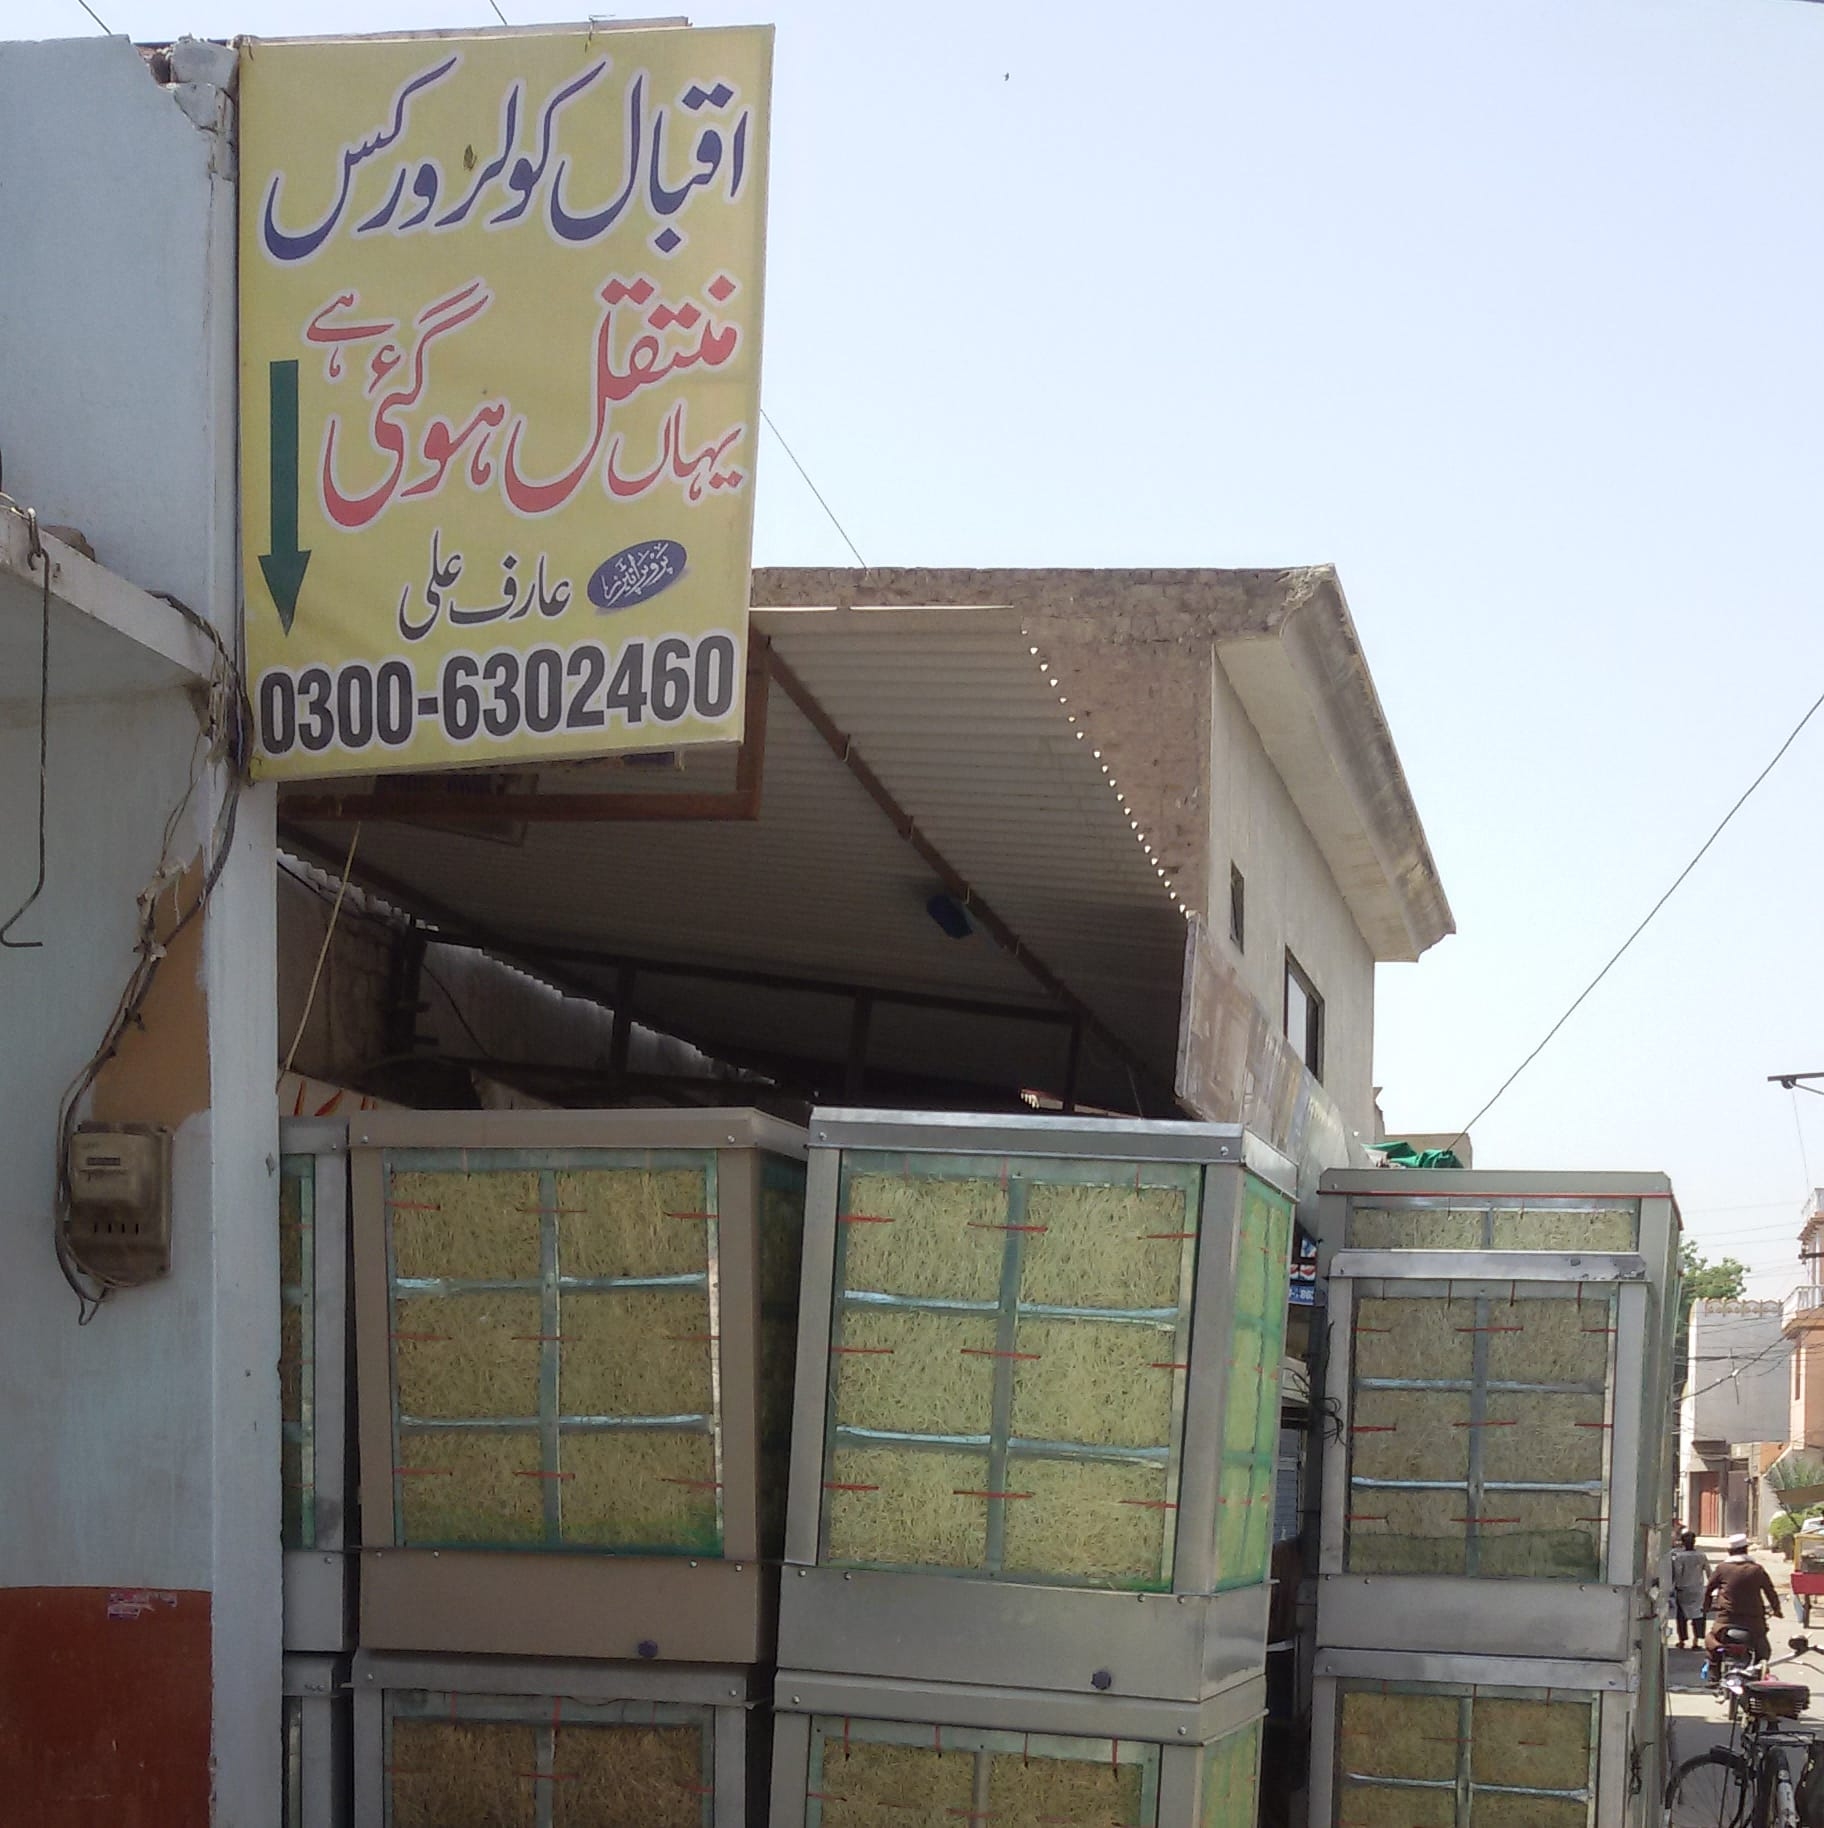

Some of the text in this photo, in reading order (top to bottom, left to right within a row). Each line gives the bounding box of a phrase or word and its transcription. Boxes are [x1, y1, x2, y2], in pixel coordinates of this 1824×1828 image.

[263, 56, 748, 260] اقبال کولر ورکس
[504, 274, 738, 513] منتقل
[607, 404, 742, 502] یہاں
[399, 529, 571, 641] عارف علی
[260, 634, 735, 756] 0300-6302460
